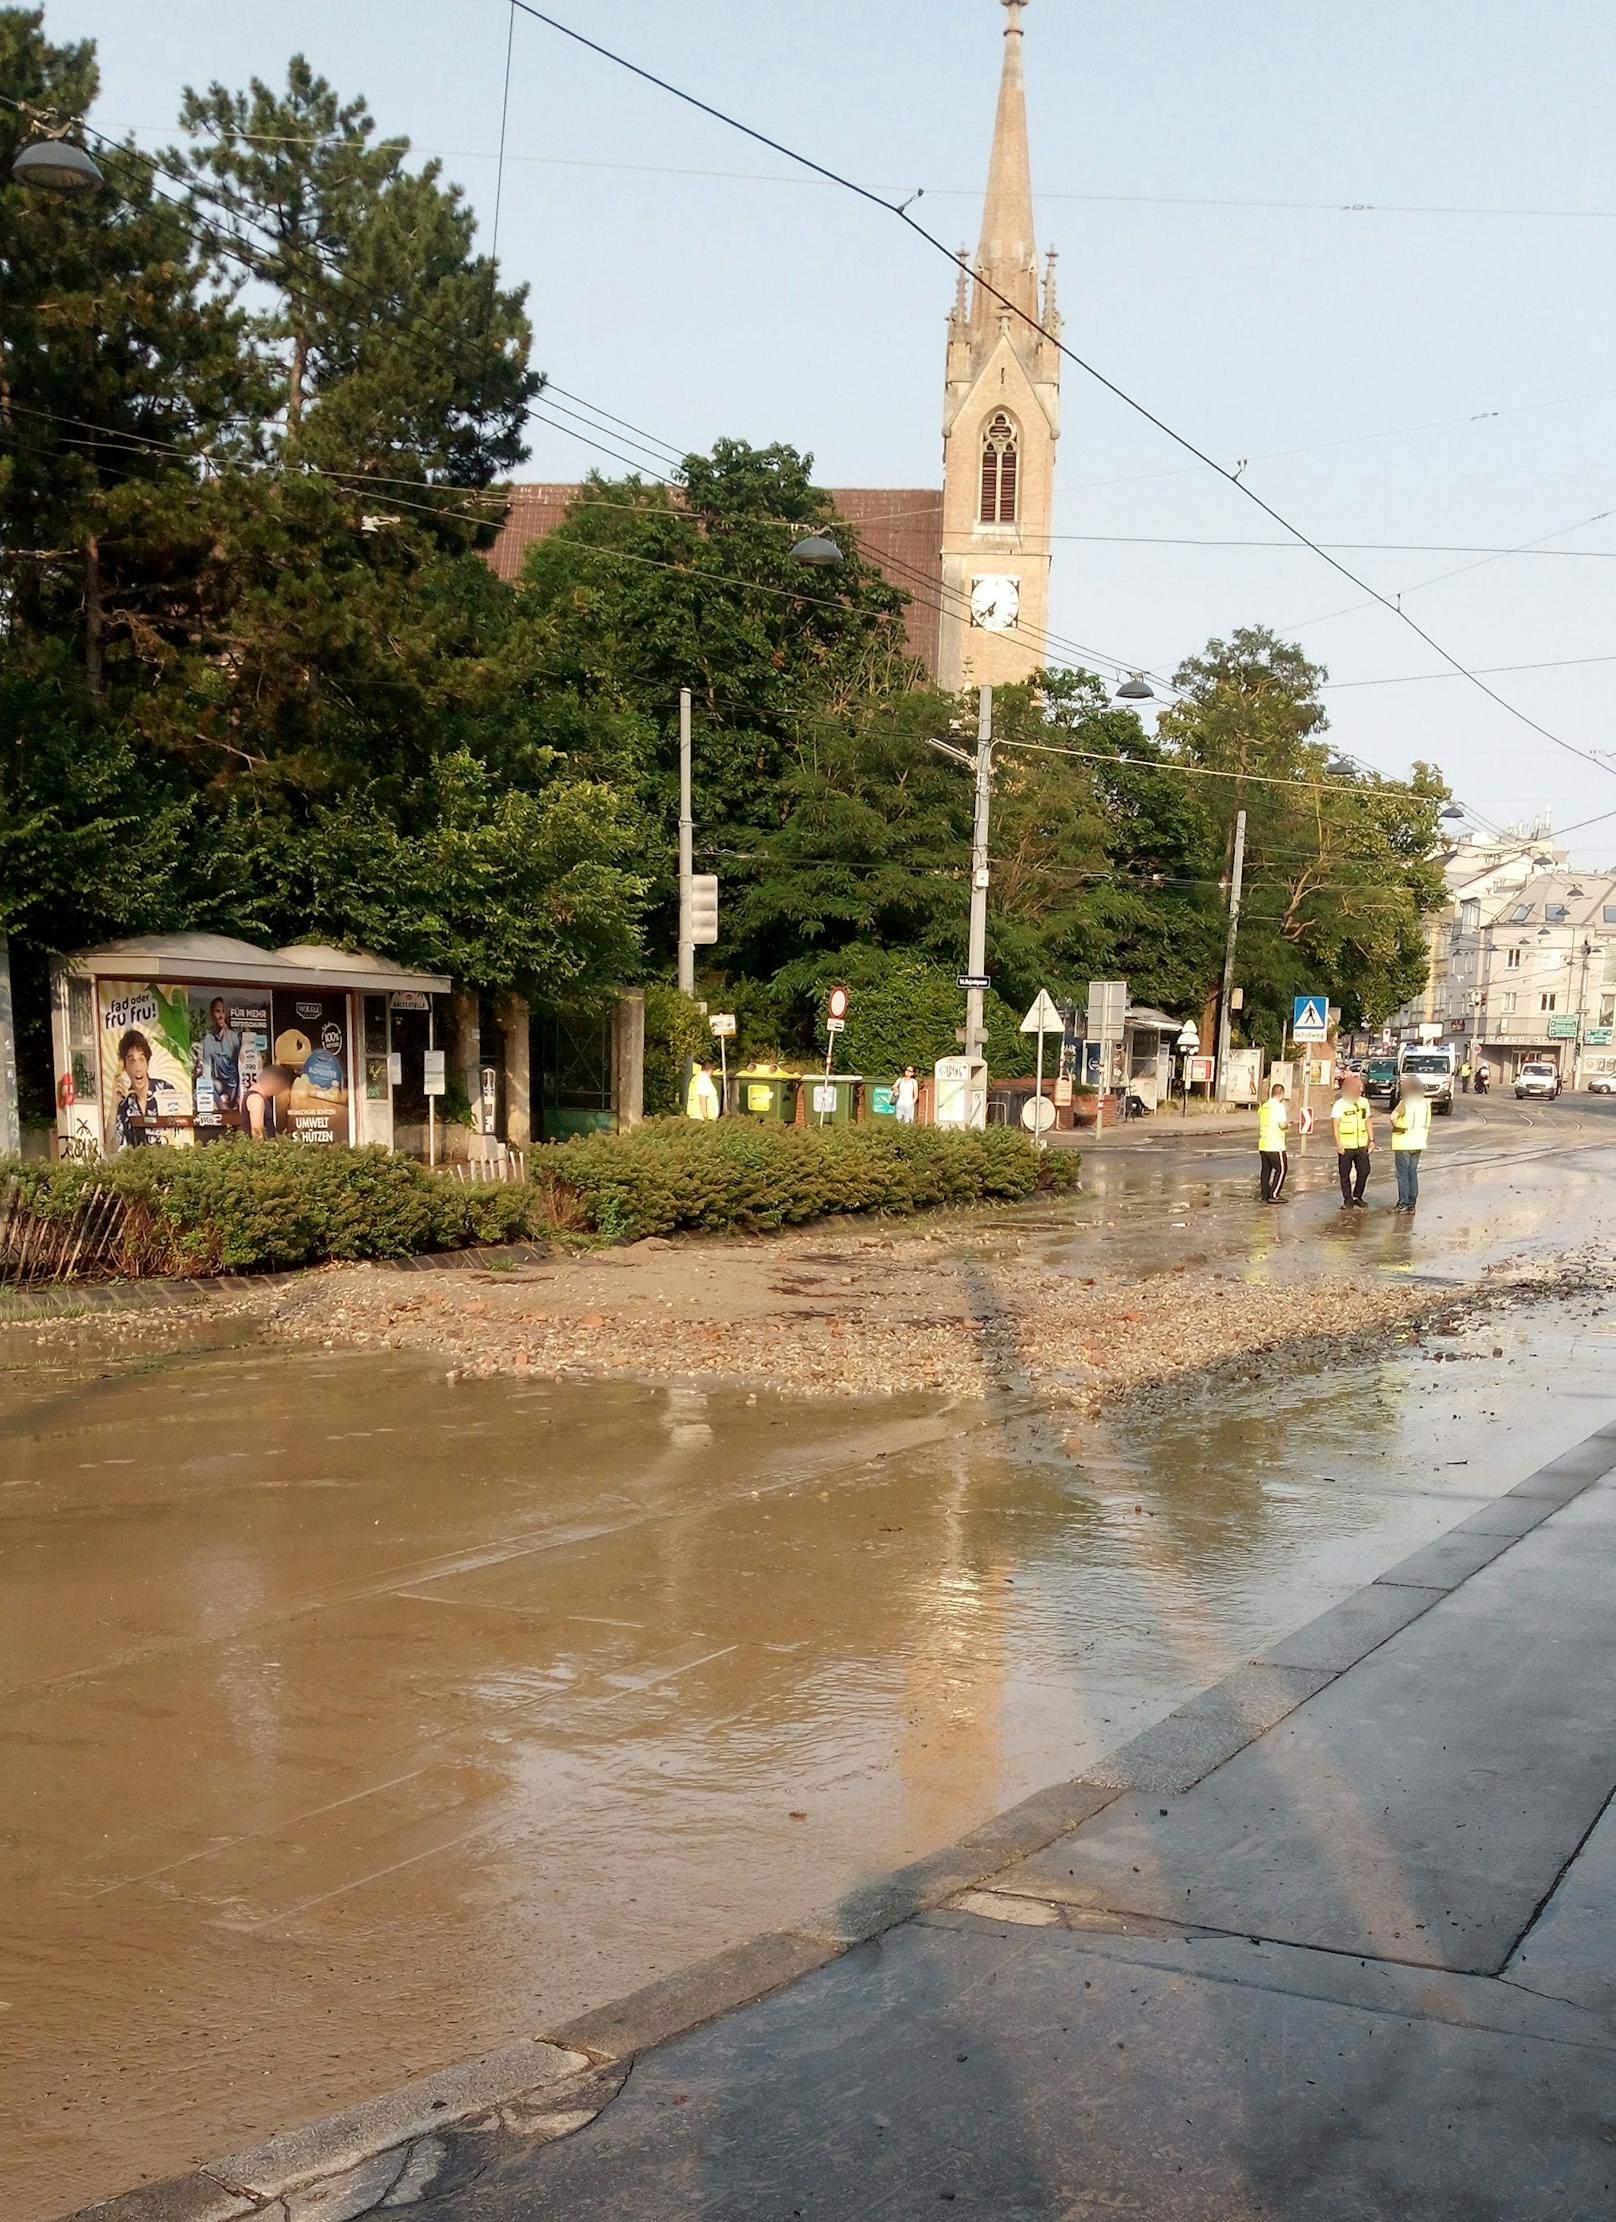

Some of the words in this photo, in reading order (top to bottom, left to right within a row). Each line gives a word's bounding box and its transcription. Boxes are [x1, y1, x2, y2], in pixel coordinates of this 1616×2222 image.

[111, 997, 128, 1013] fad
[130, 994, 150, 1005] oder
[105, 1012, 126, 1029] fru
[130, 1003, 156, 1023] fru!
[230, 1006, 245, 1017] FÜR
[246, 1009, 267, 1019] MEHR
[295, 1116, 330, 1129] UMWELT
[292, 1128, 334, 1143] SHÜTZEN
